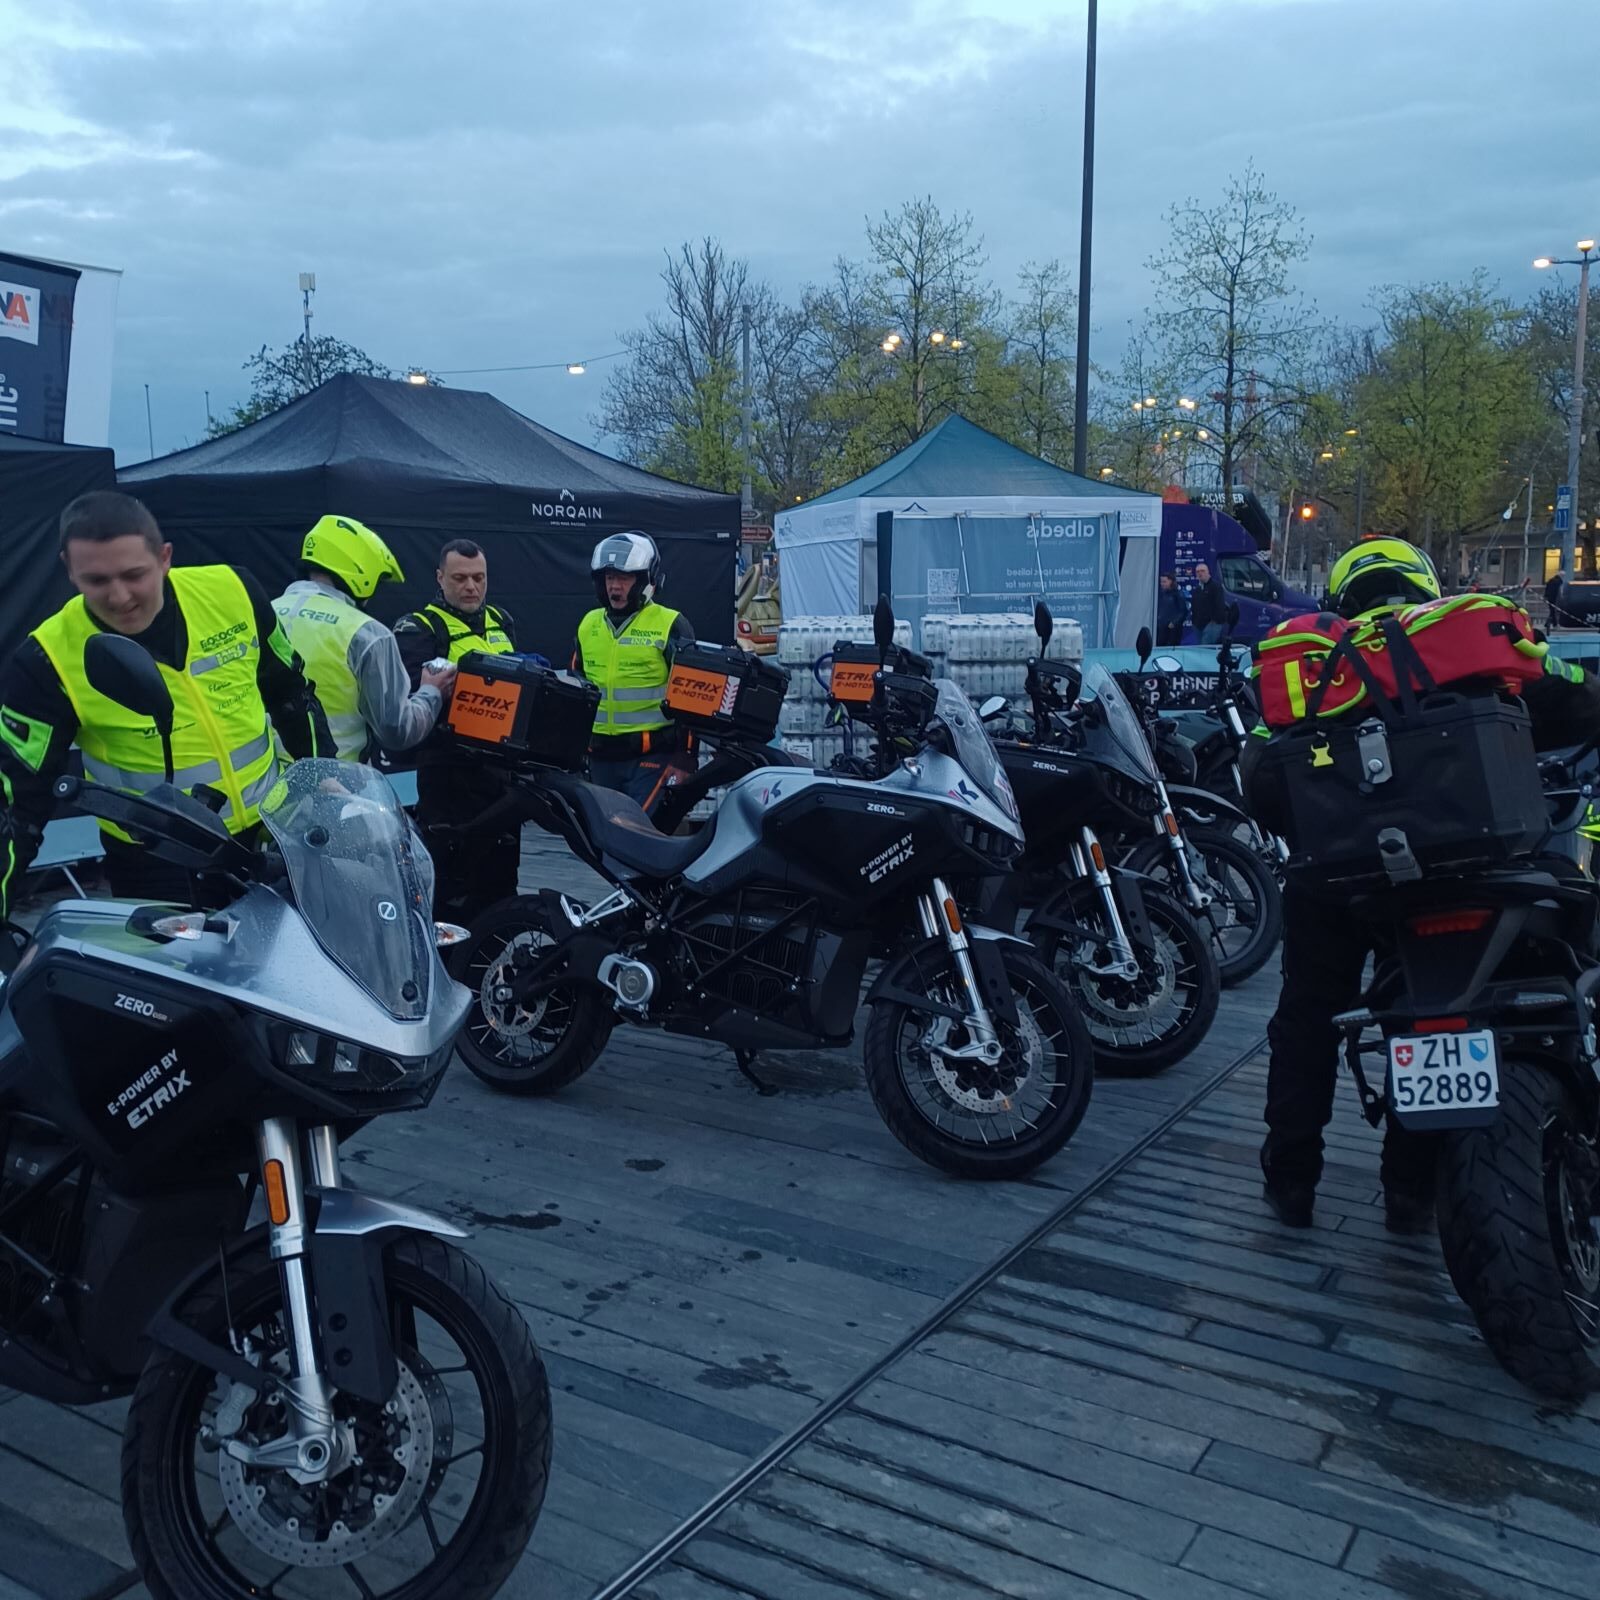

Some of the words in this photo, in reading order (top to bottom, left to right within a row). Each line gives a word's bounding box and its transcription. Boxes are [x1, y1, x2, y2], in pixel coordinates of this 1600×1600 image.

[1201, 492, 1245, 504] OCHSER
[532, 503, 602, 519] NORQAIN
[299, 608, 340, 625] CREW
[835, 672, 872, 681] ETRI
[671, 677, 722, 694] ETRIX
[456, 690, 515, 711] ETRIX
[672, 687, 716, 702] E-MOTOS
[456, 704, 507, 721] E-MOTOS
[1032, 760, 1057, 771] ZERO
[866, 802, 896, 814] ZERO
[860, 842, 900, 876] E-POWER
[900, 832, 913, 846] BY
[868, 844, 915, 884] ETRIX
[114, 993, 154, 1017] ZERO
[1421, 1036, 1462, 1069] ZH
[107, 1064, 162, 1116] E-POWER
[160, 1048, 178, 1071] BY
[1397, 1071, 1492, 1107] 52889
[126, 1069, 192, 1129] ETRIX
